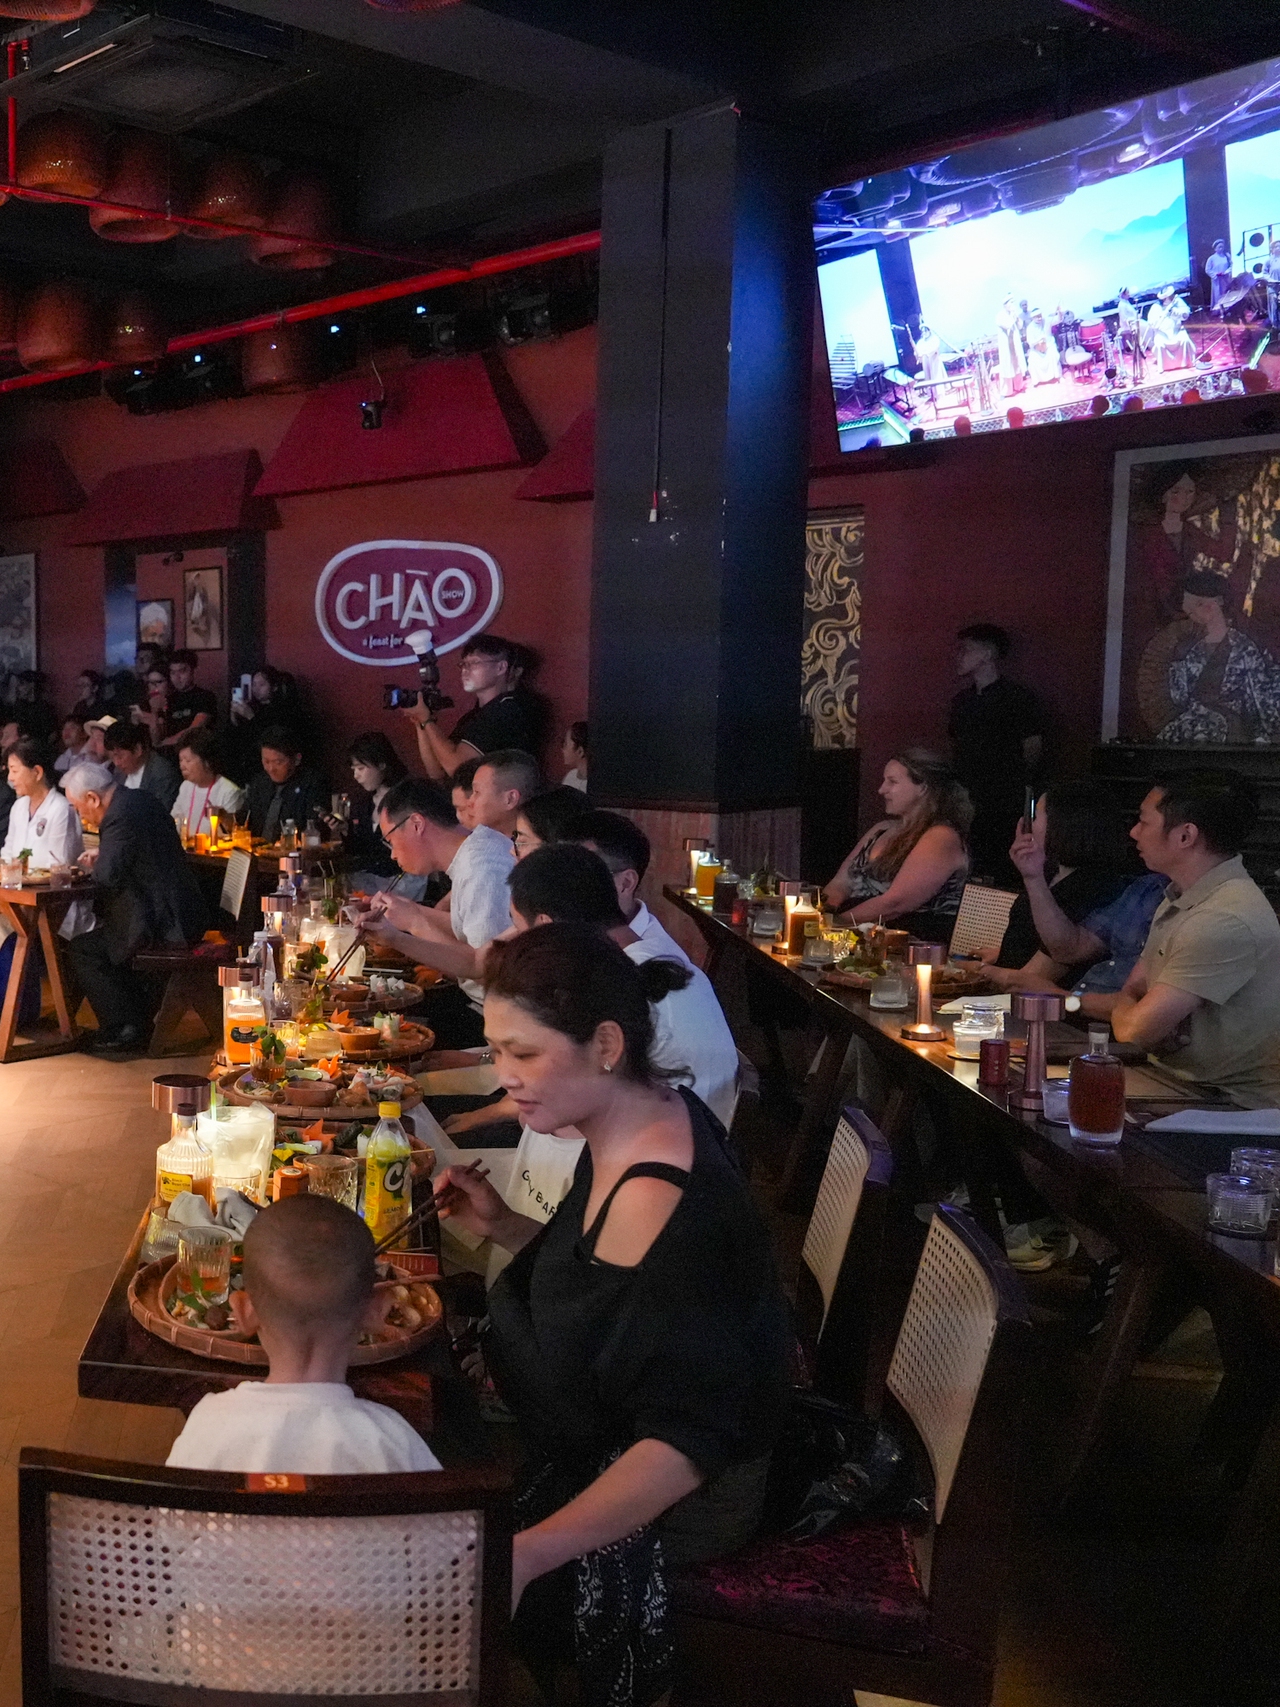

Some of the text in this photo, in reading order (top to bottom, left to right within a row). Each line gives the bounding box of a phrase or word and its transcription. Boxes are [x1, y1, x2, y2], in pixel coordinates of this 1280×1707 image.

[441, 590, 465, 599] SHOW
[368, 634, 389, 649] feast
[389, 633, 404, 648] for
[263, 1474, 289, 1489] S3
